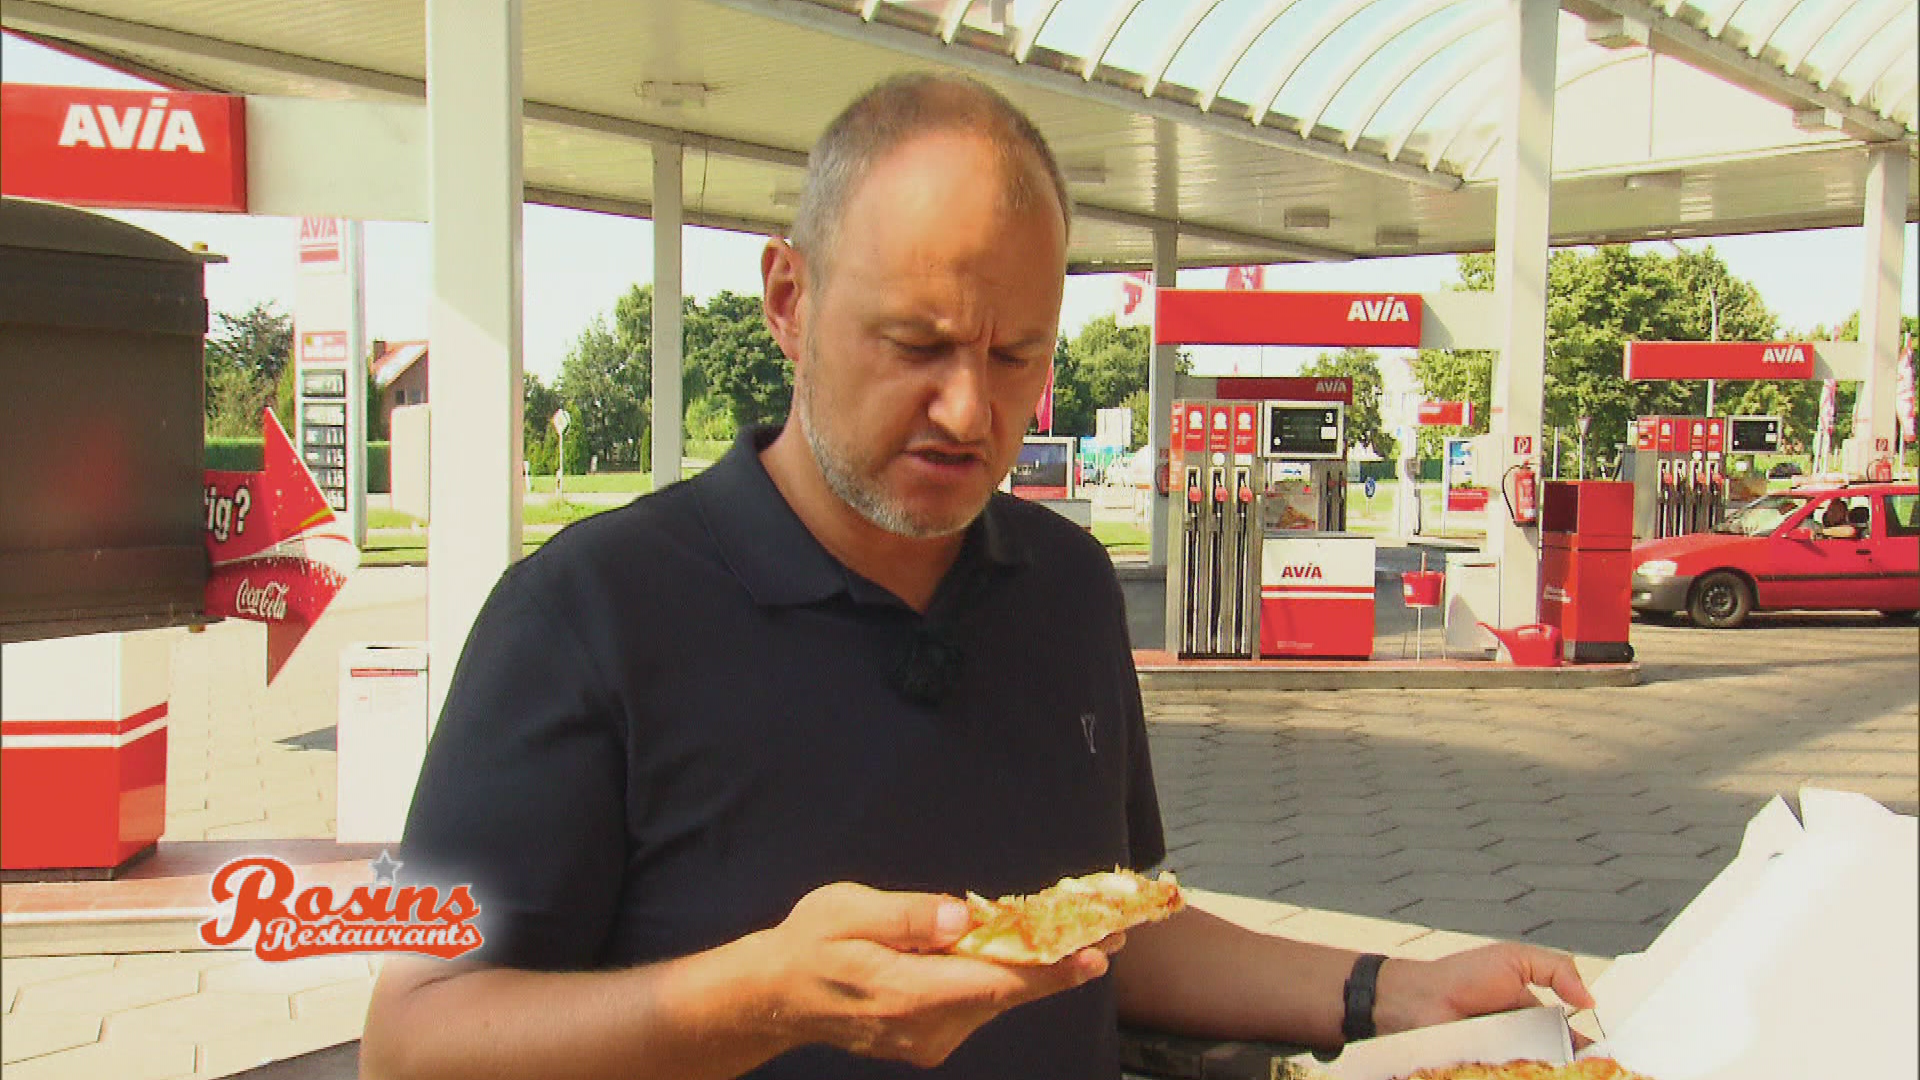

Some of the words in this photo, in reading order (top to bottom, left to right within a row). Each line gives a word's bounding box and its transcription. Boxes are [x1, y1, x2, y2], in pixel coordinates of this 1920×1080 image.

[58, 97, 206, 153] AVIA
[1346, 296, 1410, 322] AVIA
[1761, 345, 1806, 364] AVIA
[1315, 379, 1348, 394] AVIA
[1281, 563, 1323, 579] AVIA
